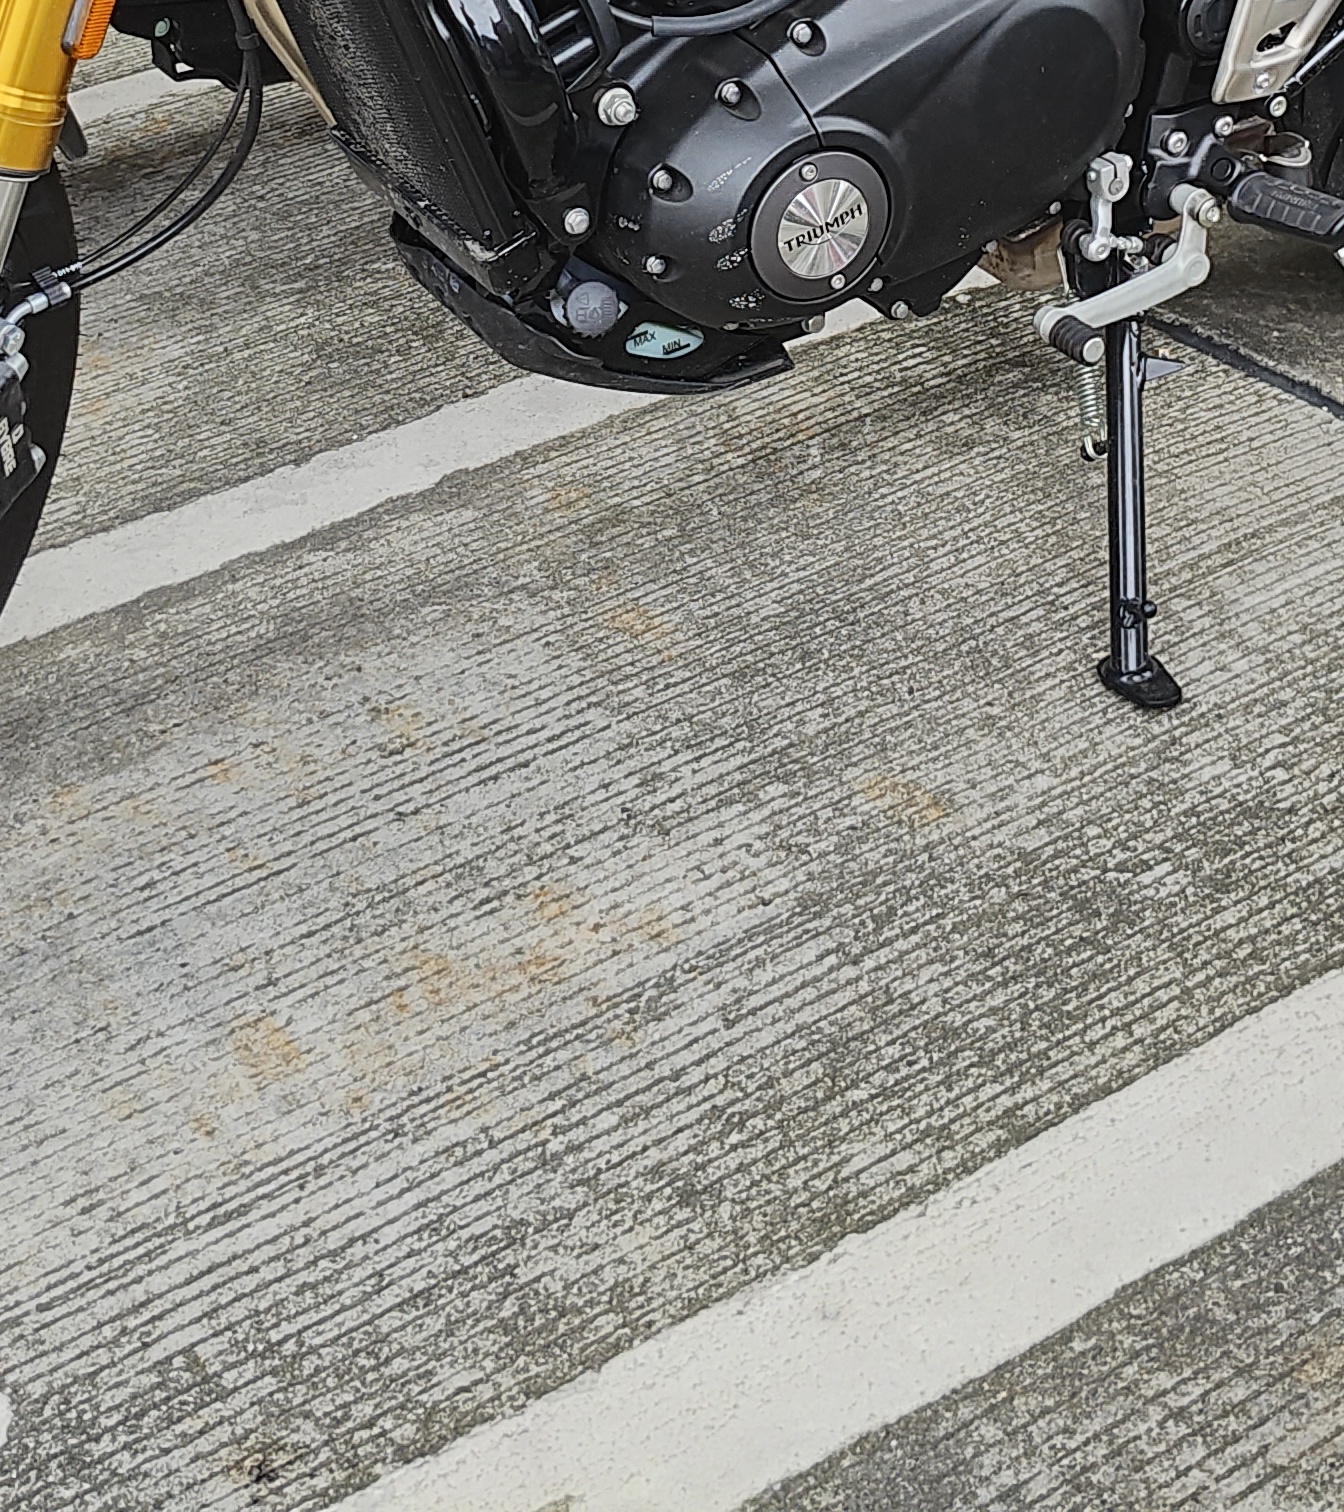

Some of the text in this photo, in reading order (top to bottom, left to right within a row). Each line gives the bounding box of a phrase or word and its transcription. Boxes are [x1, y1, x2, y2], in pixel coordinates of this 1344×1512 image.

[783, 202, 864, 253] TRIUMPH
[633, 331, 657, 348] MAX
[662, 338, 682, 355] MIN
